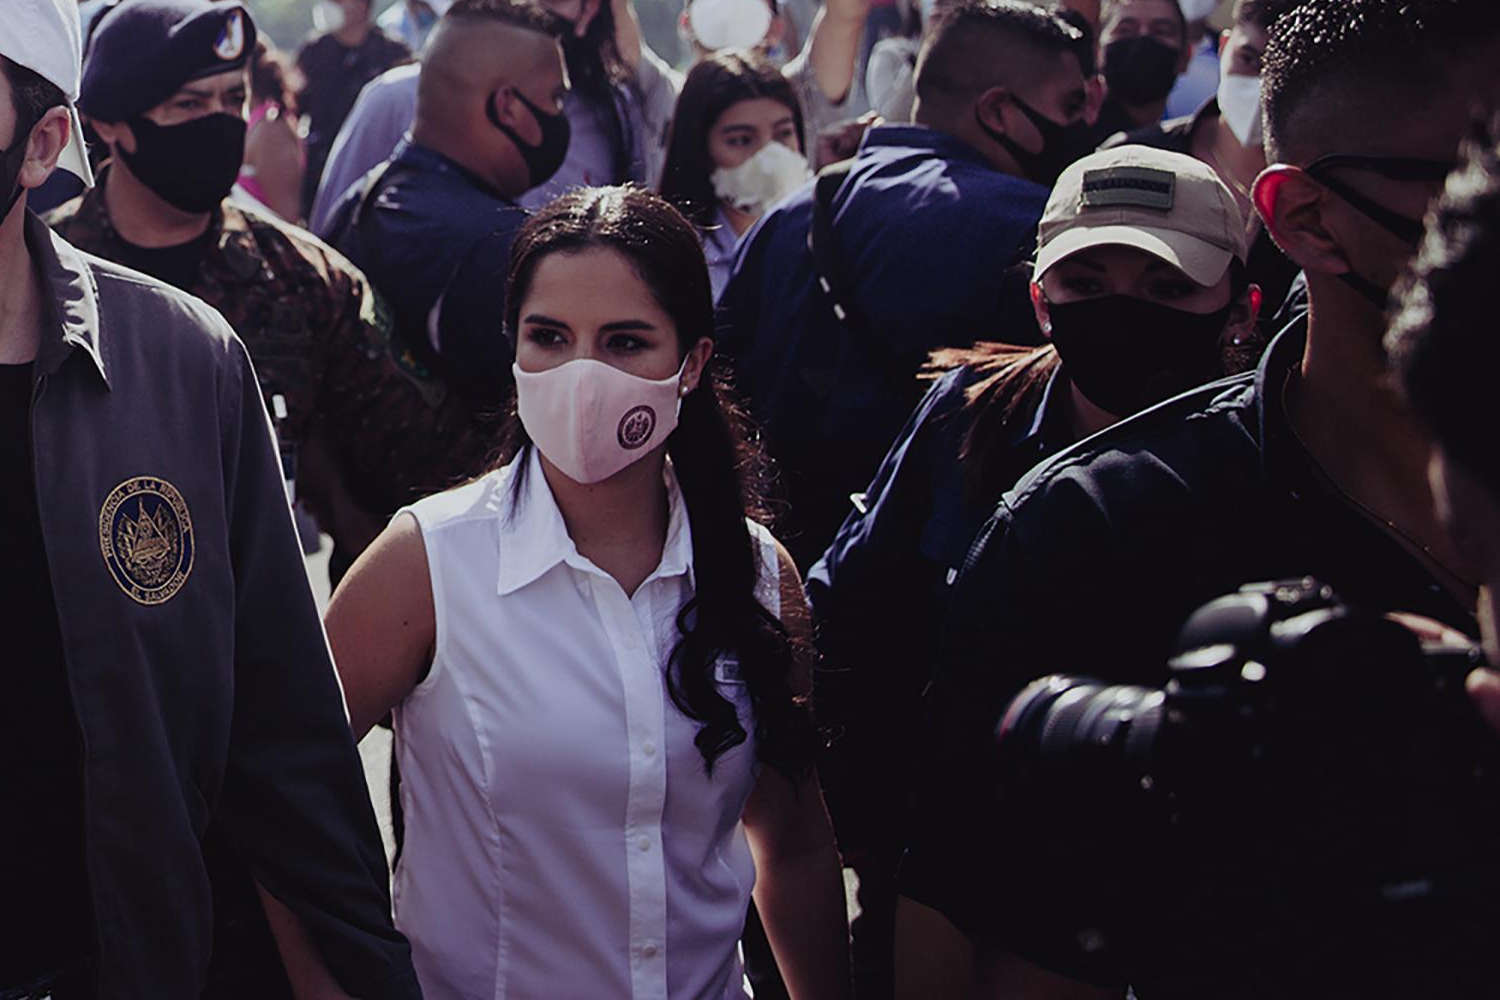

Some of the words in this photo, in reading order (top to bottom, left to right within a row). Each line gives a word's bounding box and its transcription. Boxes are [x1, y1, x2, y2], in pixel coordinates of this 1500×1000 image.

[101, 491, 125, 557] PRESIDENCIA
[127, 481, 141, 493] DE
[143, 480, 156, 490] LA
[131, 586, 141, 598] EL
[145, 571, 185, 601] SALVADOR
